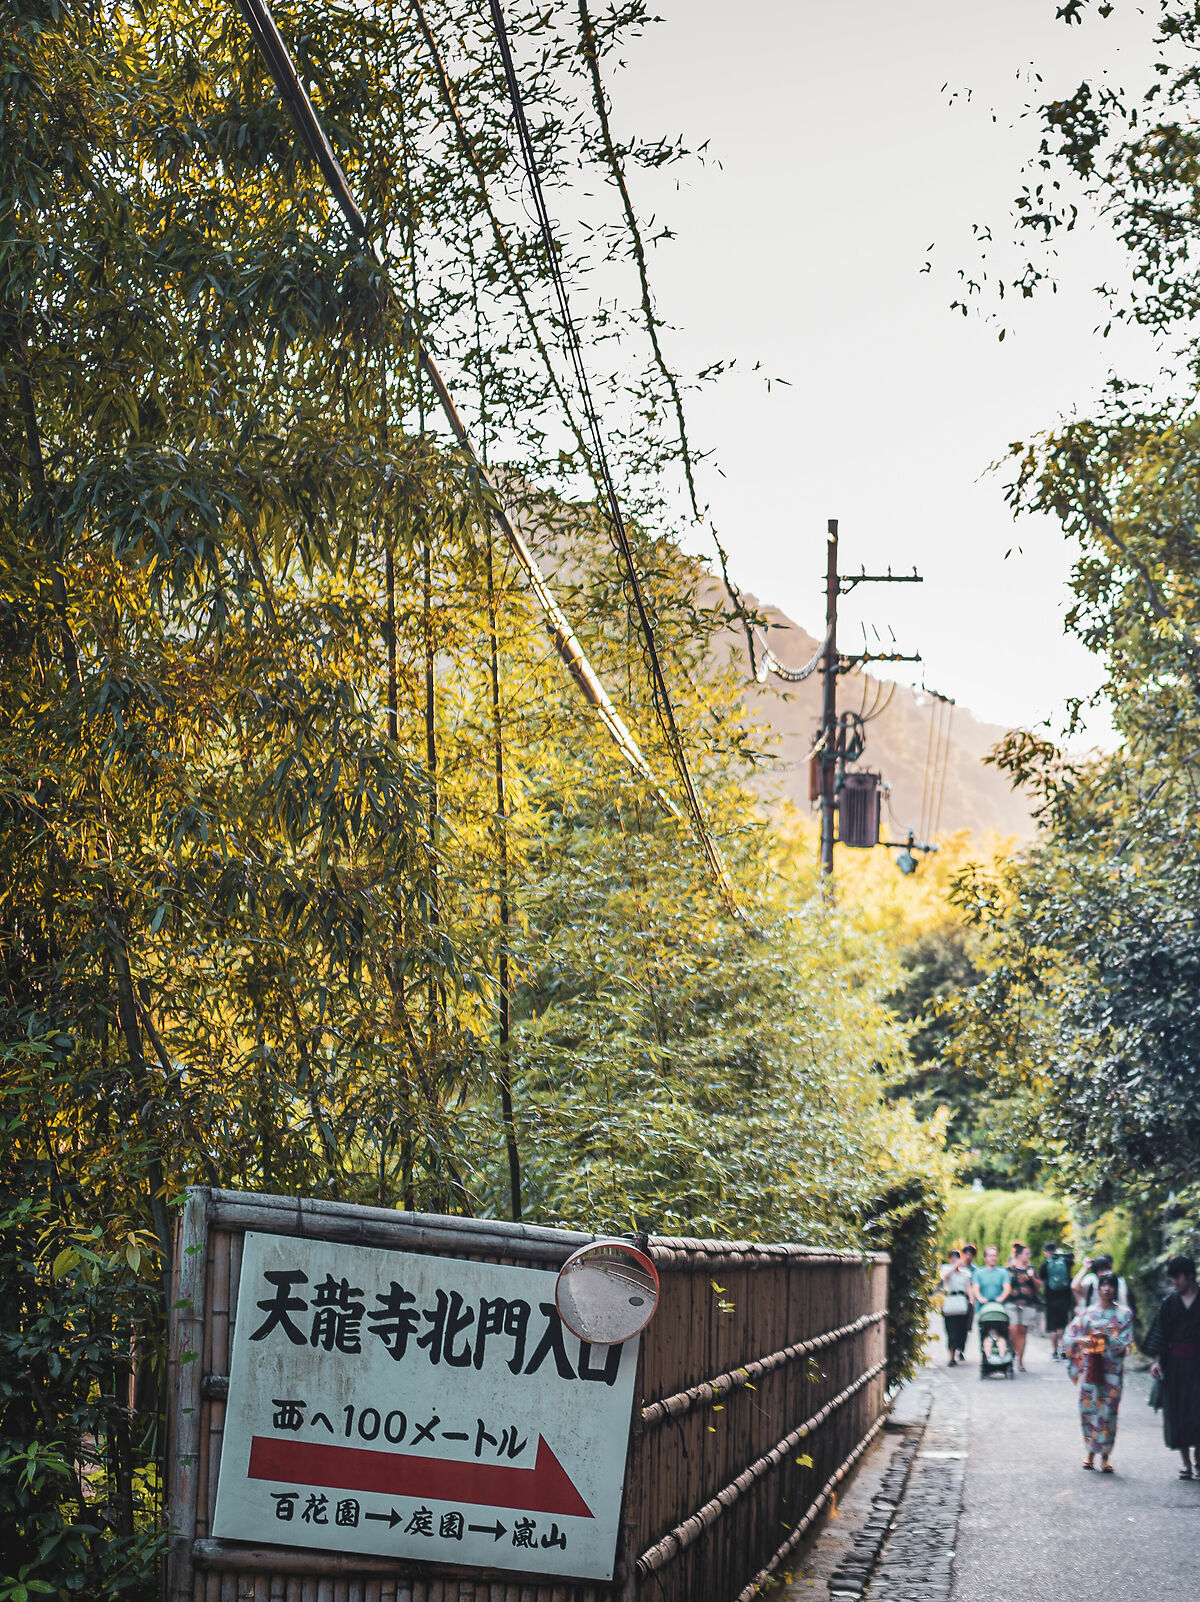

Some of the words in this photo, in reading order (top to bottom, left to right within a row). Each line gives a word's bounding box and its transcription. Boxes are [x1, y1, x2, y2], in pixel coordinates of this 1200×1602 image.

[271, 1398, 528, 1460] 西へ100メートル
[270, 1491, 361, 1529] 百花園
[404, 1505, 465, 1542] 庭園
[511, 1516, 567, 1551] 嵐山
